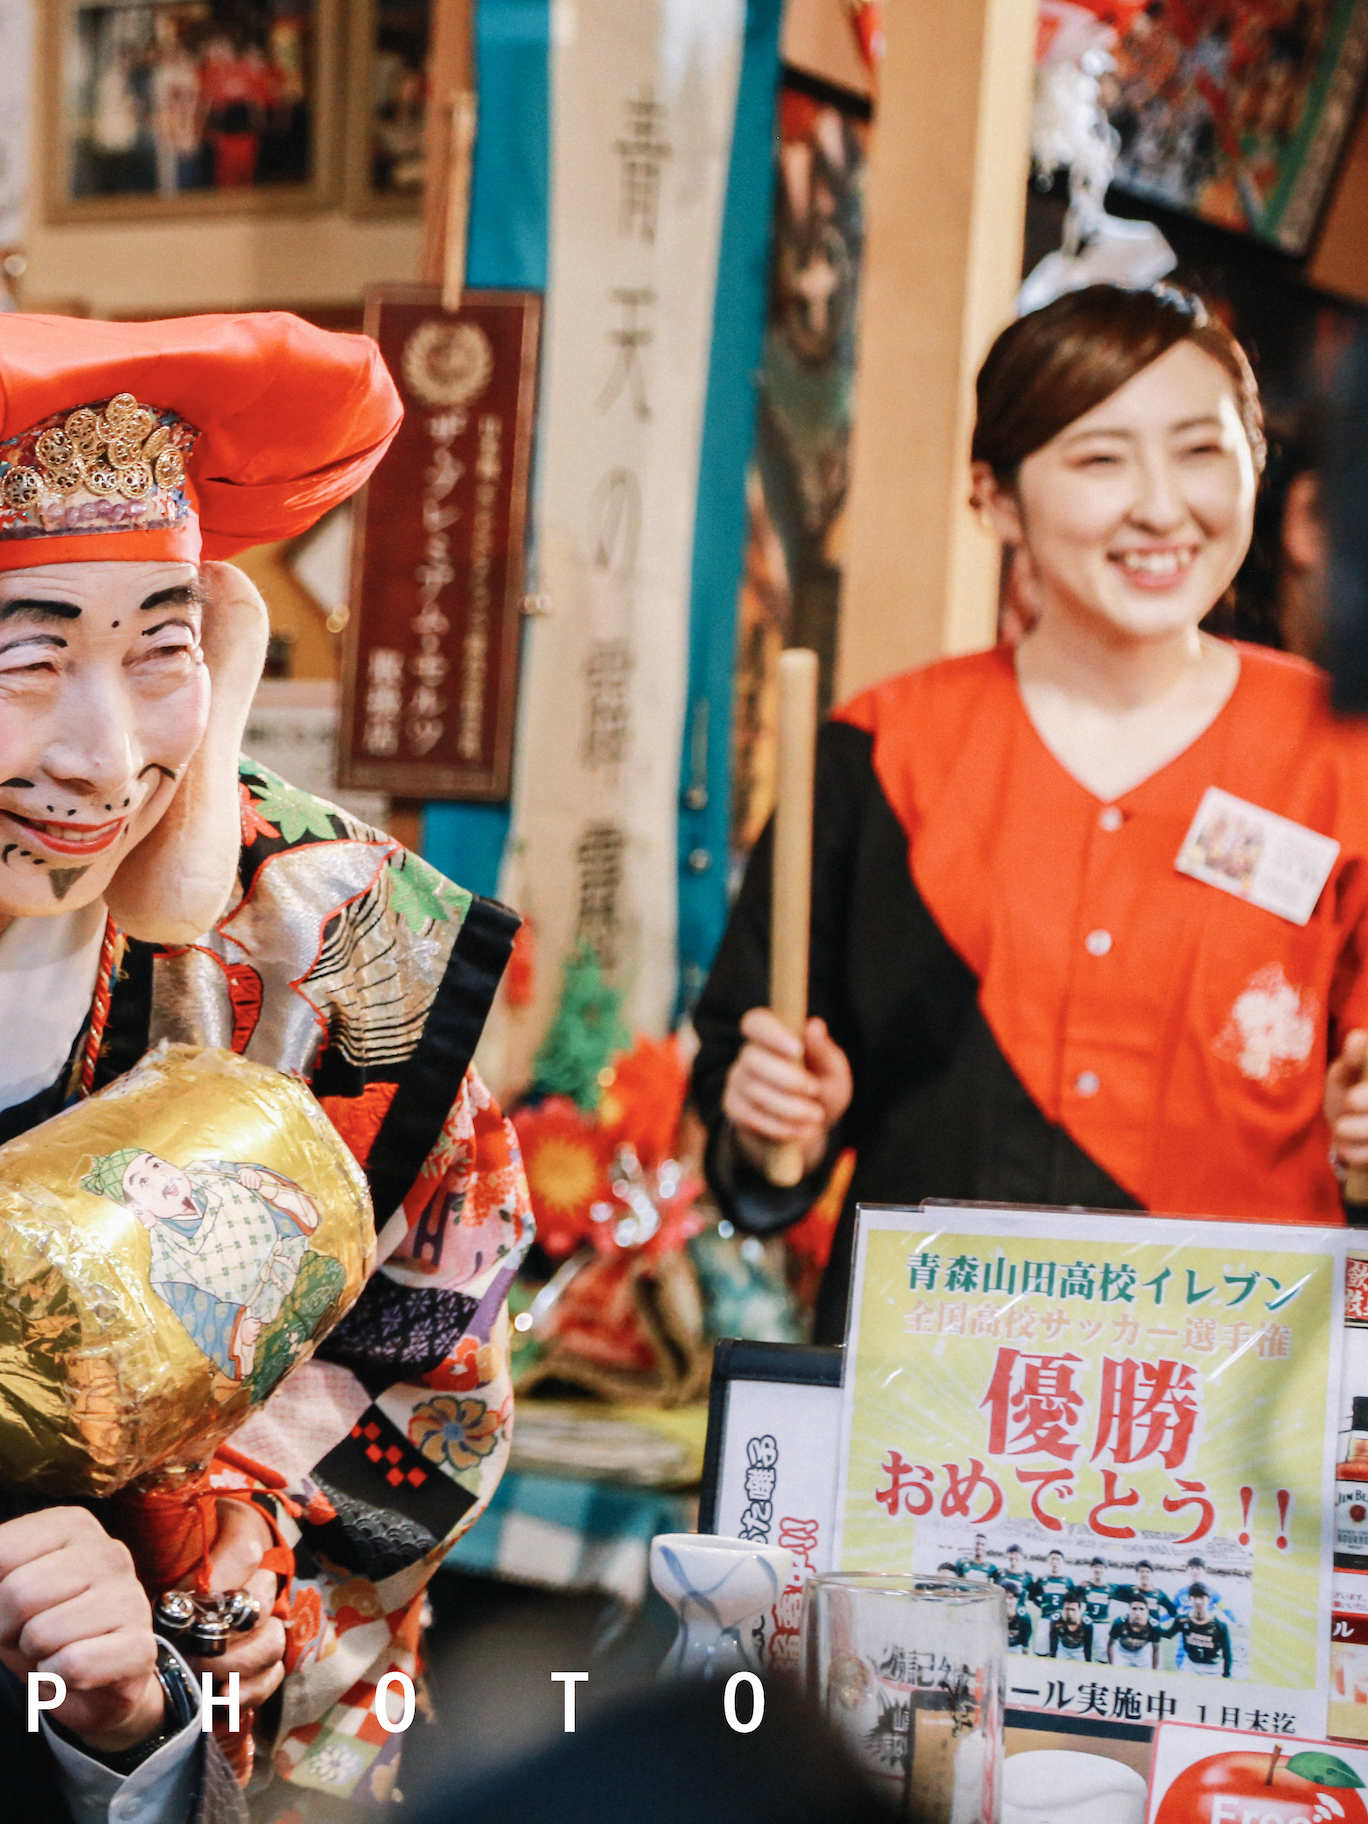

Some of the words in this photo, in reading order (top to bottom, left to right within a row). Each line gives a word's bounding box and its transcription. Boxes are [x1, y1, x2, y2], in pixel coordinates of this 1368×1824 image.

[905, 1252, 1301, 1311] 青森山田高校イレブン
[902, 1300, 1293, 1359] 全国高校サッカー選手権
[980, 1346, 1200, 1470] 優勝
[875, 1450, 1291, 1550] おめでとう!!
